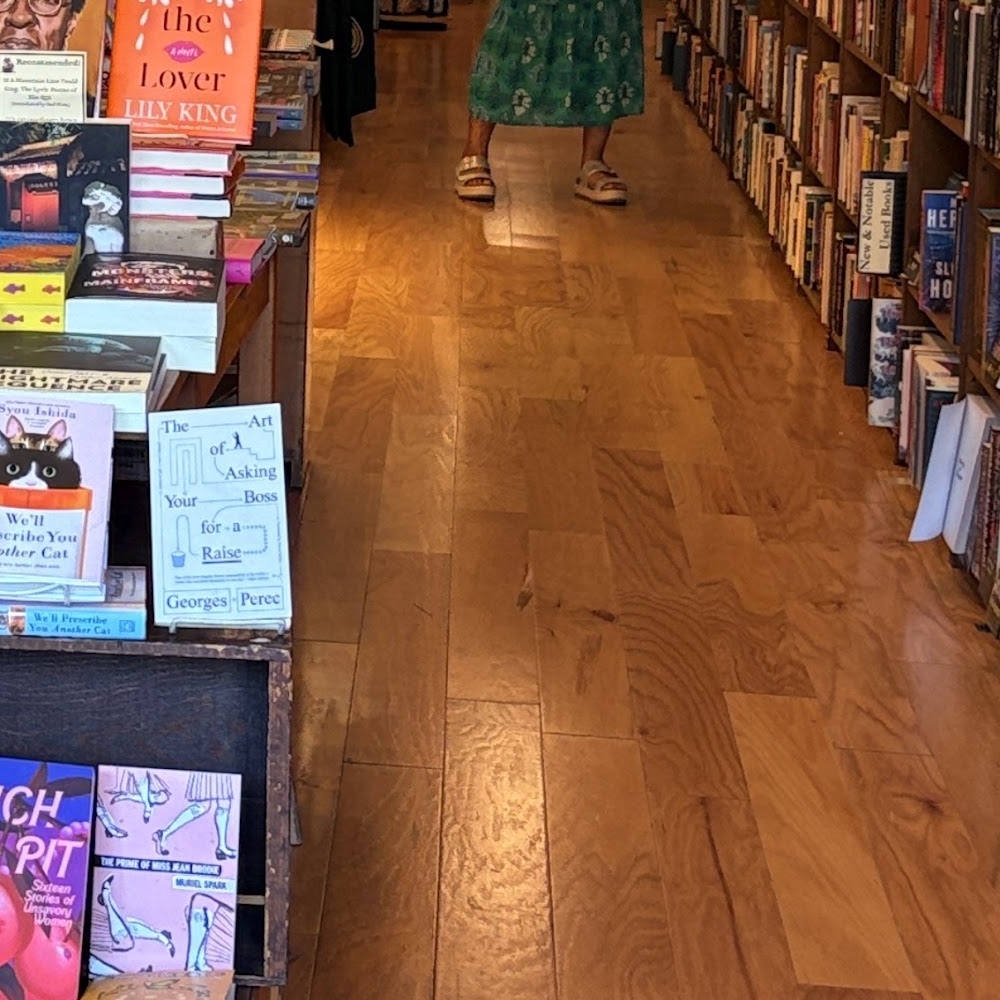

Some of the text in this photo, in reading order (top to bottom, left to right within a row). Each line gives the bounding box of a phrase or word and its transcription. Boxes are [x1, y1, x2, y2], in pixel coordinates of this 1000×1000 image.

[163, 7, 211, 33] the
[140, 63, 226, 92] Lover
[124, 99, 237, 124] LILY KING
[879, 181, 894, 250] Used Books
[860, 179, 874, 271] New & Notable
[0, 404, 77, 419] Syou Ishida
[161, 414, 274, 434] The Art
[209, 441, 227, 456] of
[224, 464, 277, 483] Asking
[164, 489, 278, 508] Your Boss
[6, 512, 45, 527] We'll
[200, 520, 242, 535] for a
[47, 530, 78, 544] You
[41, 545, 69, 560] Cat
[201, 546, 243, 561] Raise
[166, 592, 281, 612] Georges Perec
[28, 623, 93, 634] You Another
[14, 834, 85, 879] PIT
[116, 858, 170, 873] PRIME OF MISS
[30, 879, 72, 894] Sixteen
[203, 879, 227, 891] SPARK
[23, 889, 75, 906] Stories of
[34, 913, 73, 928] Women
